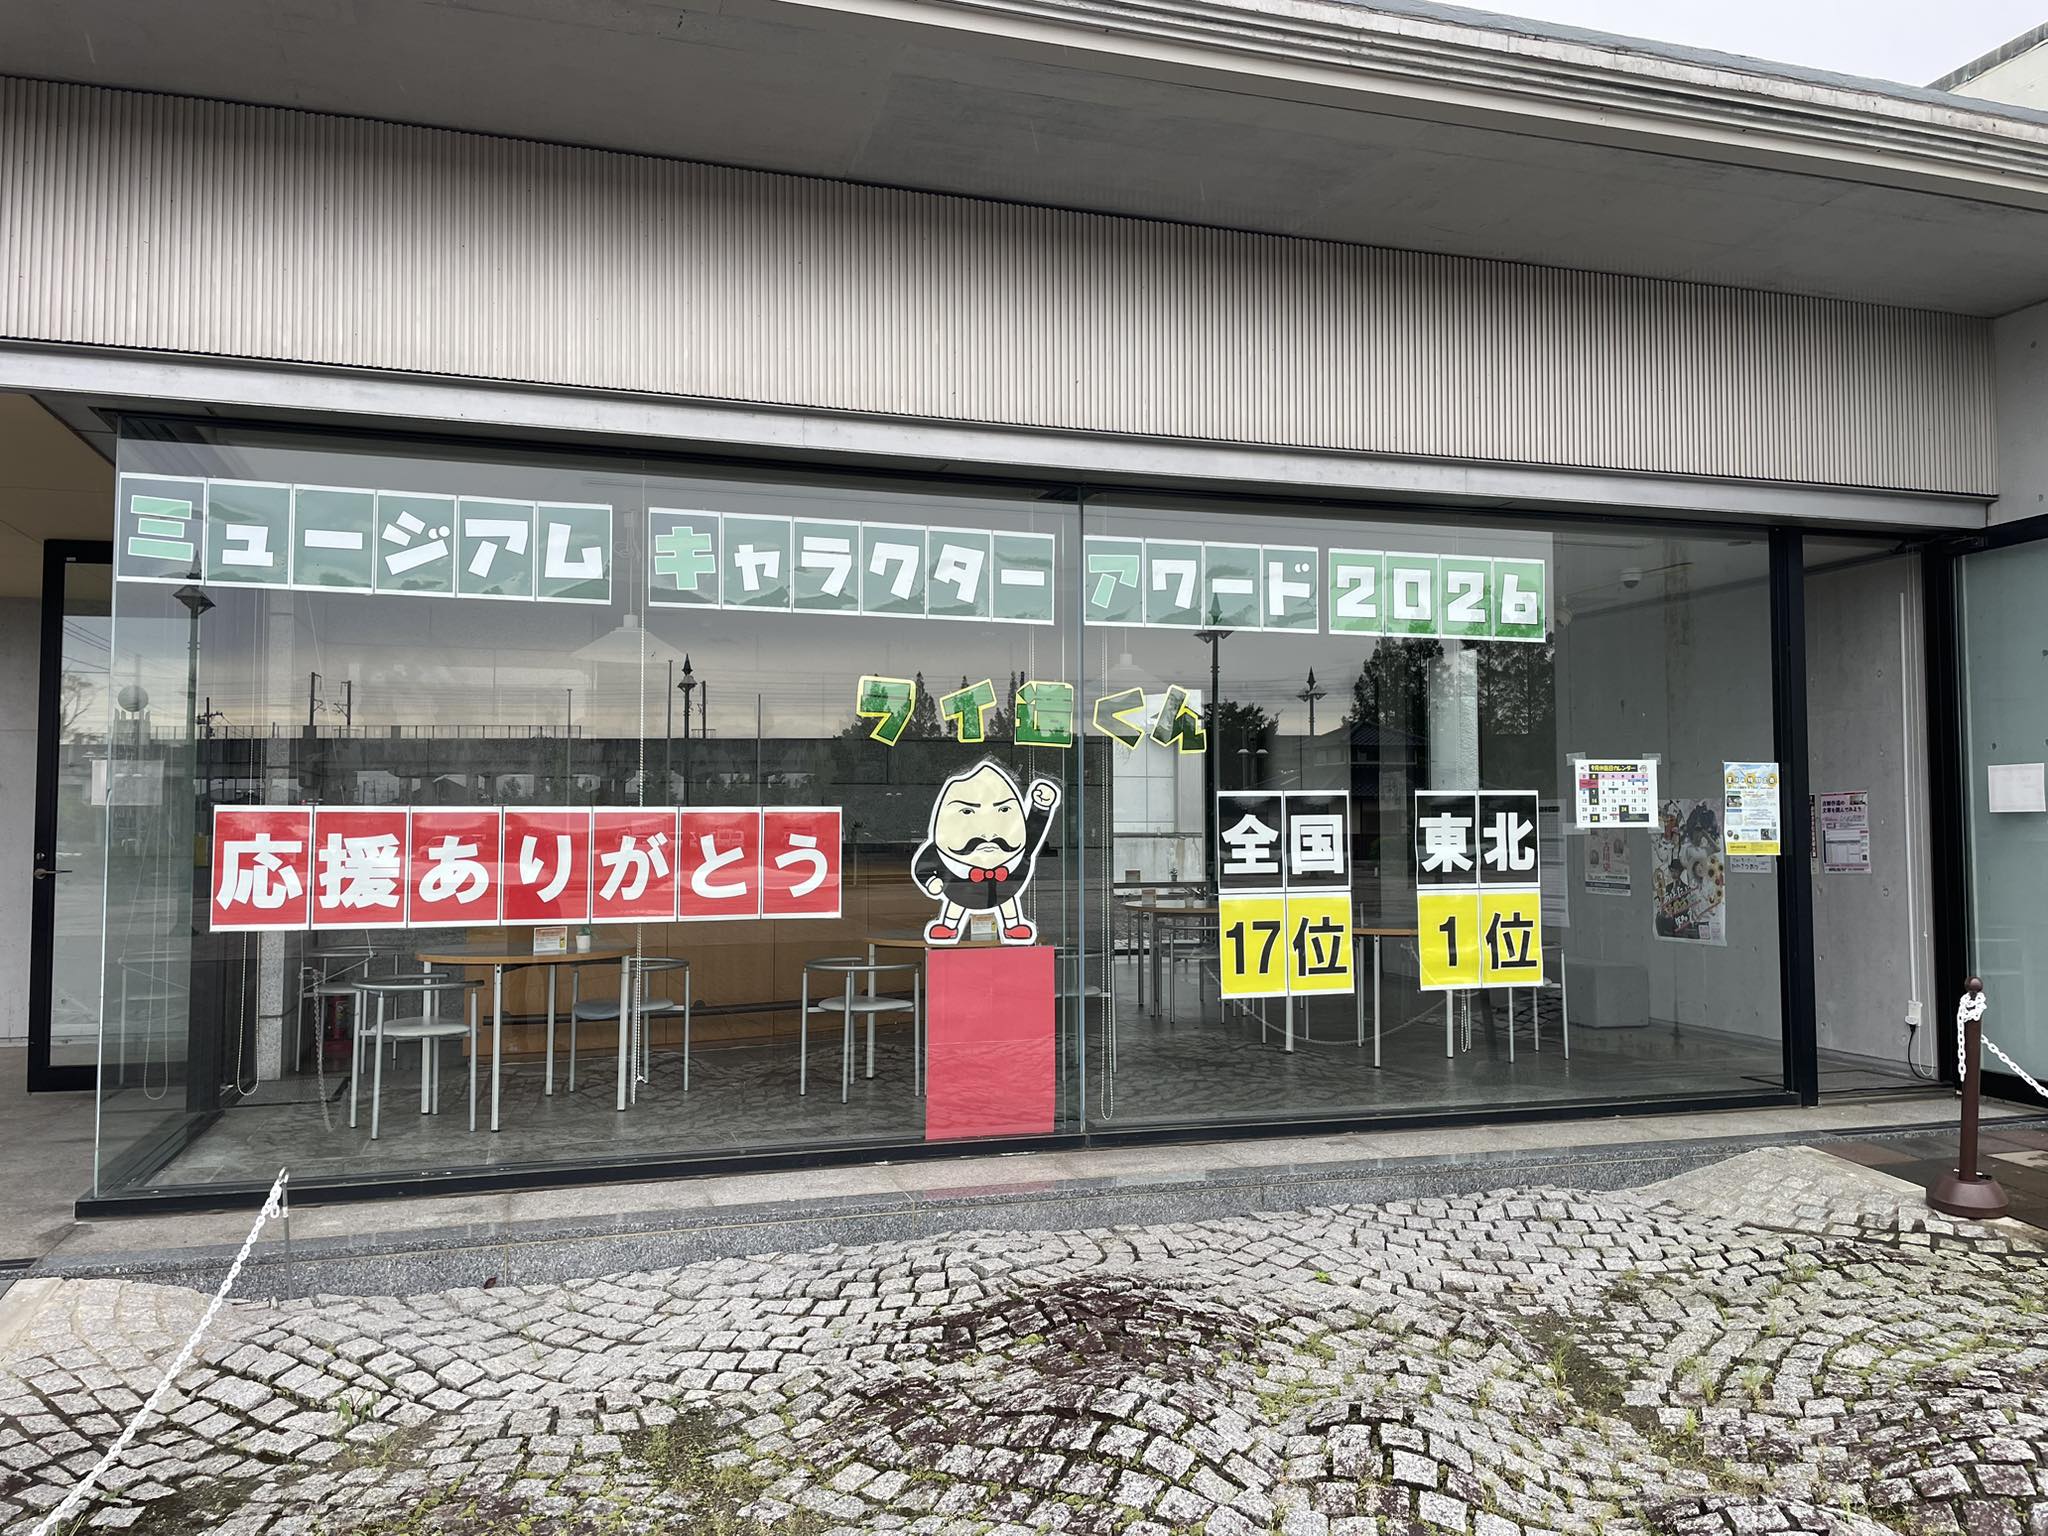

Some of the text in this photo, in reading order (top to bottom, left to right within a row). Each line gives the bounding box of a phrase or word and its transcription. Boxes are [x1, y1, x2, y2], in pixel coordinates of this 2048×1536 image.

[127, 494, 1538, 625] ミュージアム キャラクター アワード 2026
[216, 831, 830, 911] 応援ありがとう
[1221, 813, 1345, 875] 全国
[1419, 812, 1535, 873] 東北
[1225, 916, 1348, 977] 17位
[1439, 911, 1538, 971] 1位
